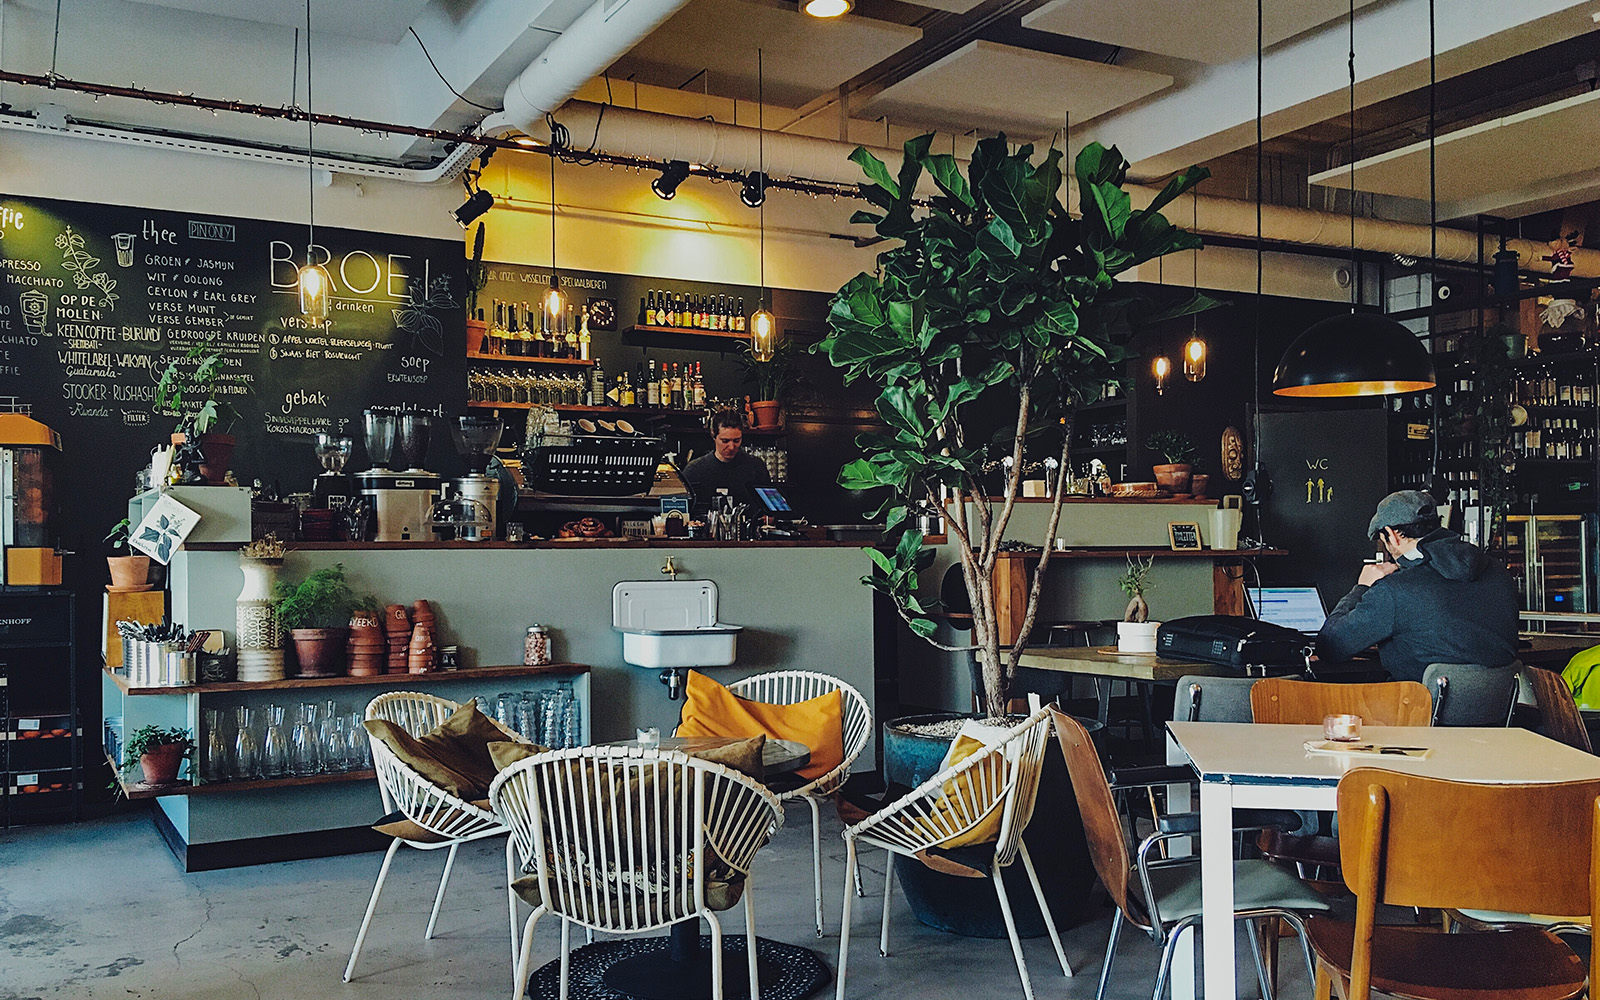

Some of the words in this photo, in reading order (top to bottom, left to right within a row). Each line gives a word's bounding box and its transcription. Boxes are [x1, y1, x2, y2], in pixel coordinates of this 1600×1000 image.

[142, 219, 178, 245] thee
[145, 253, 182, 267] GROEN
[197, 258, 235, 271] JASMIJN
[6, 274, 64, 288] MACCHIATO
[147, 272, 167, 282] WIT
[183, 274, 223, 286] OOLONG
[60, 294, 78, 306] OP
[81, 295, 97, 308] DE
[147, 286, 188, 299] CEYLON
[204, 291, 227, 302] EARL
[230, 293, 257, 304] GREY
[149, 302, 183, 312] VERSE
[188, 304, 216, 315] MUNT
[335, 301, 375, 314] drinken
[149, 314, 181, 325] VERSE
[184, 315, 225, 328] GEMBER
[280, 316, 309, 330] vers
[226, 331, 266, 343] KRUIDEN
[401, 356, 430, 373] soep
[62, 383, 107, 401] STOOKER
[281, 389, 327, 414] gebak
[1305, 458, 1329, 470] WC
